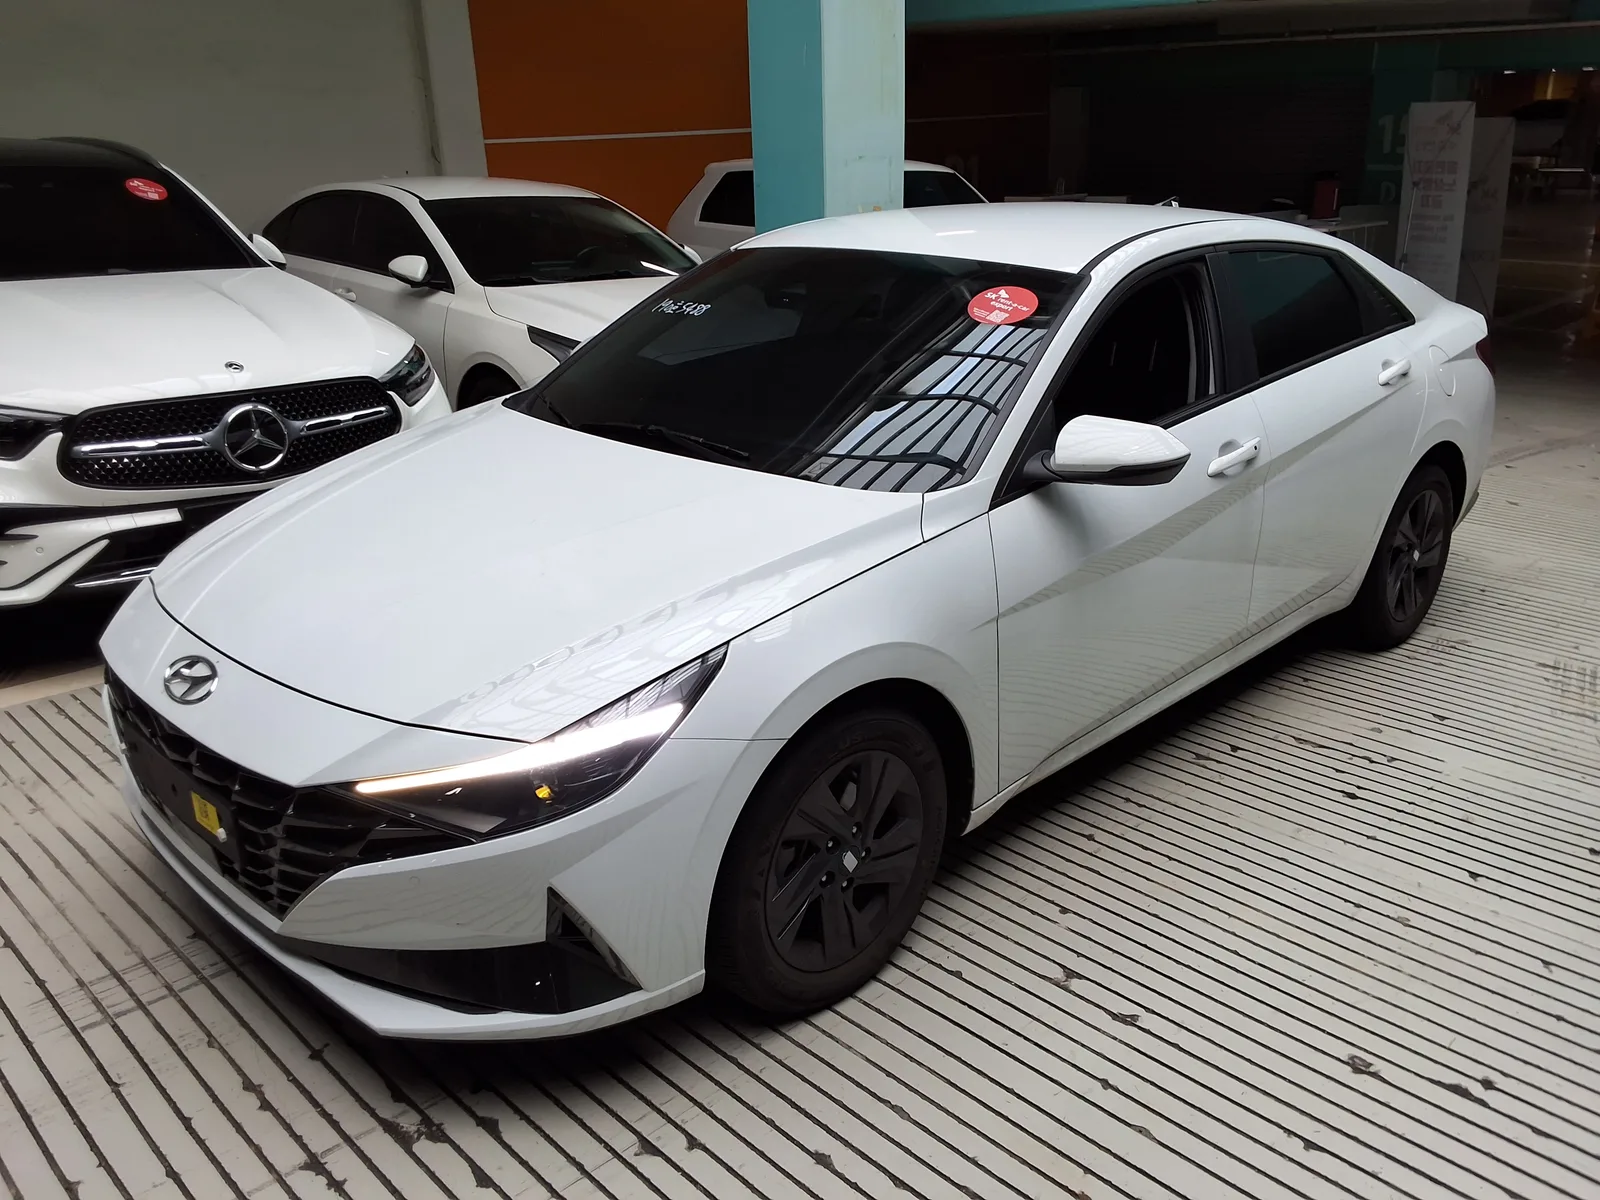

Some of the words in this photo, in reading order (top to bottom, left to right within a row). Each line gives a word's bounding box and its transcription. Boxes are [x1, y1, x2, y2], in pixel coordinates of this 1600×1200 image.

[984, 291, 999, 300] SK
[997, 298, 1030, 312] rent-a-car
[990, 301, 1014, 312] export
